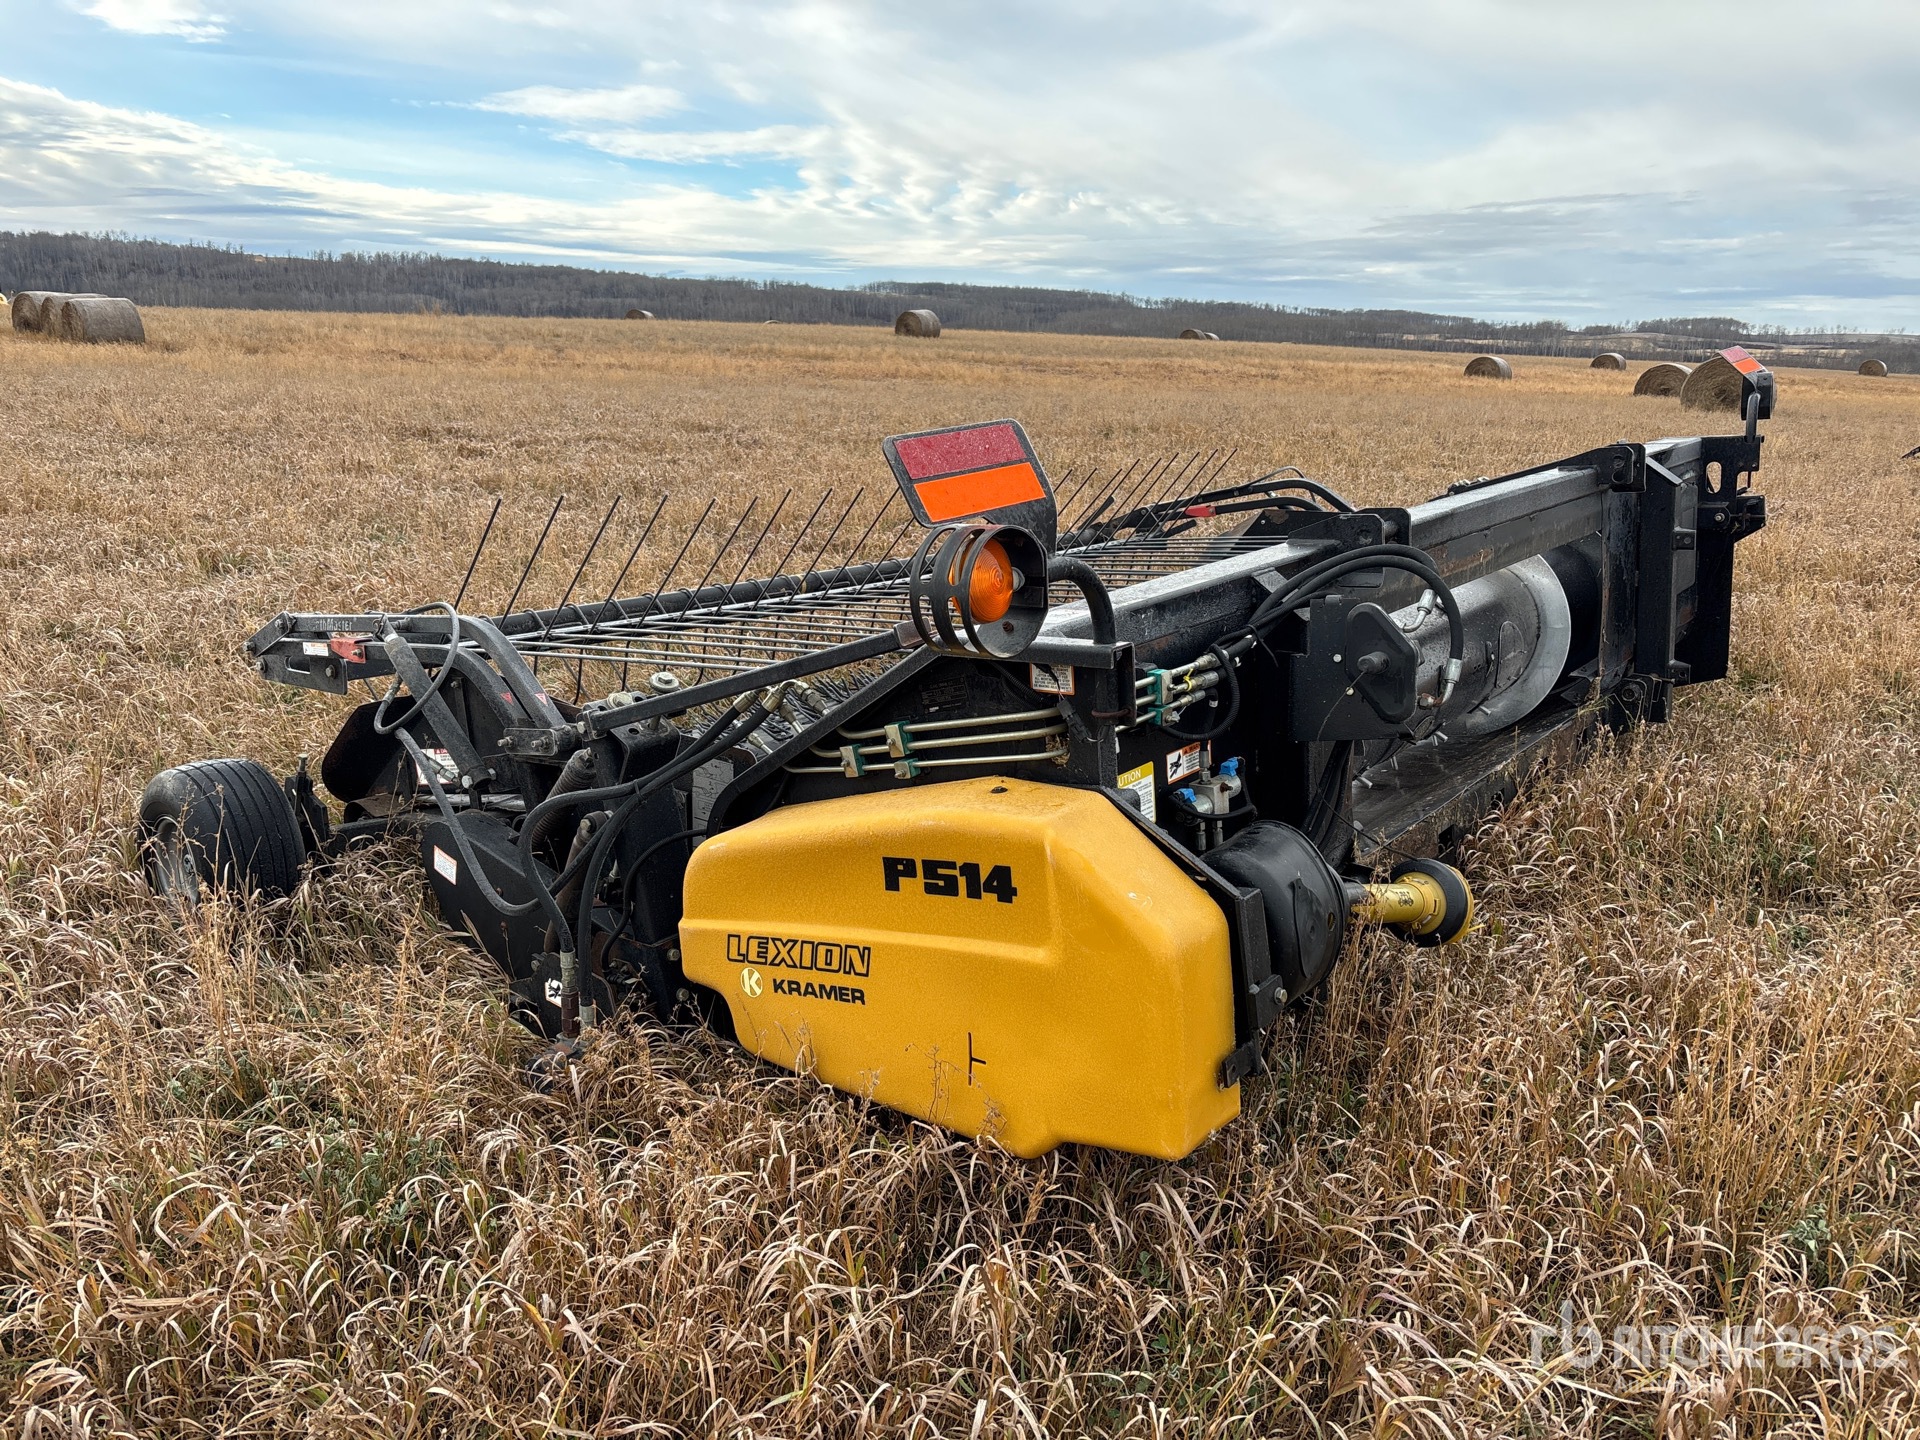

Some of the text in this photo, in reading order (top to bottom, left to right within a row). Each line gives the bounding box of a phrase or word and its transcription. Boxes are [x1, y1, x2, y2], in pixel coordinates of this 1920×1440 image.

[1118, 769, 1141, 787] UTION
[727, 933, 872, 978] LEXION
[772, 978, 866, 1006] KRAMER
